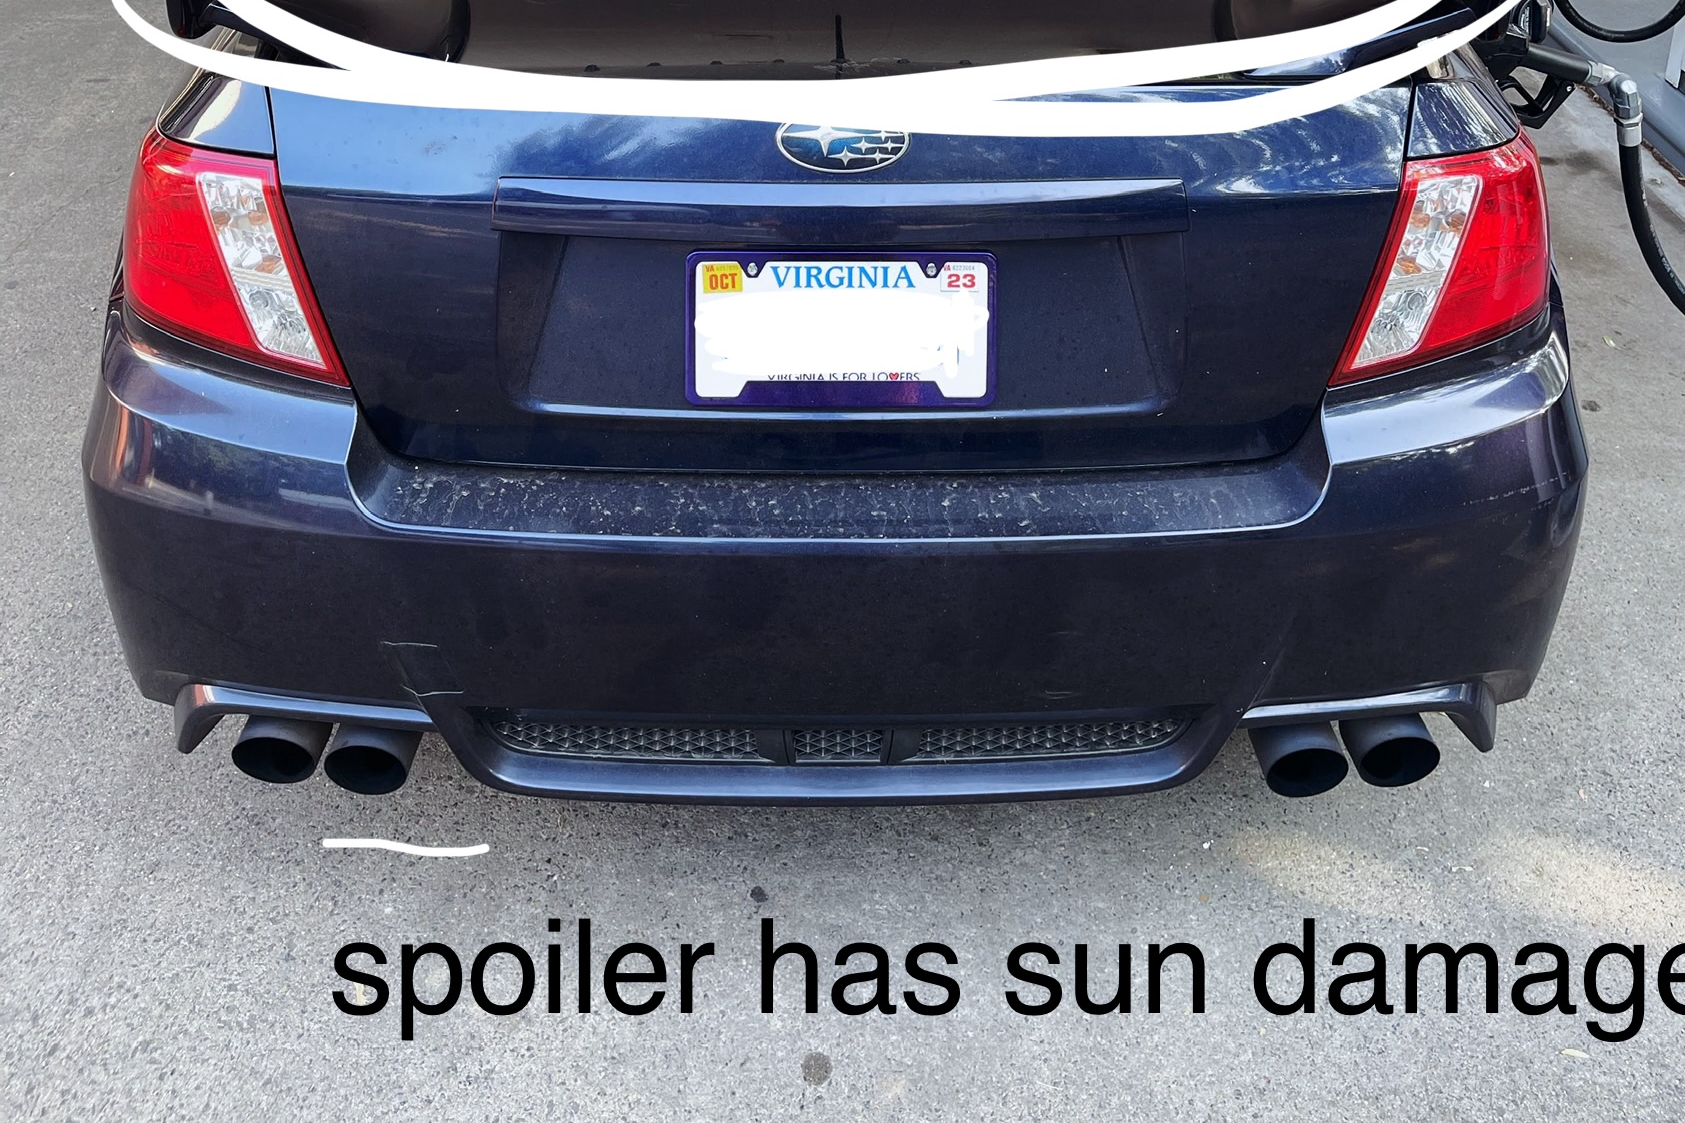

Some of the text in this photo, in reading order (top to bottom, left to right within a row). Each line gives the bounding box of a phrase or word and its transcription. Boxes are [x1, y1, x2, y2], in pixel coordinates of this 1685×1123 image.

[708, 273, 738, 290] OCT
[770, 265, 915, 288] VIRGINIA
[947, 273, 976, 288] 23
